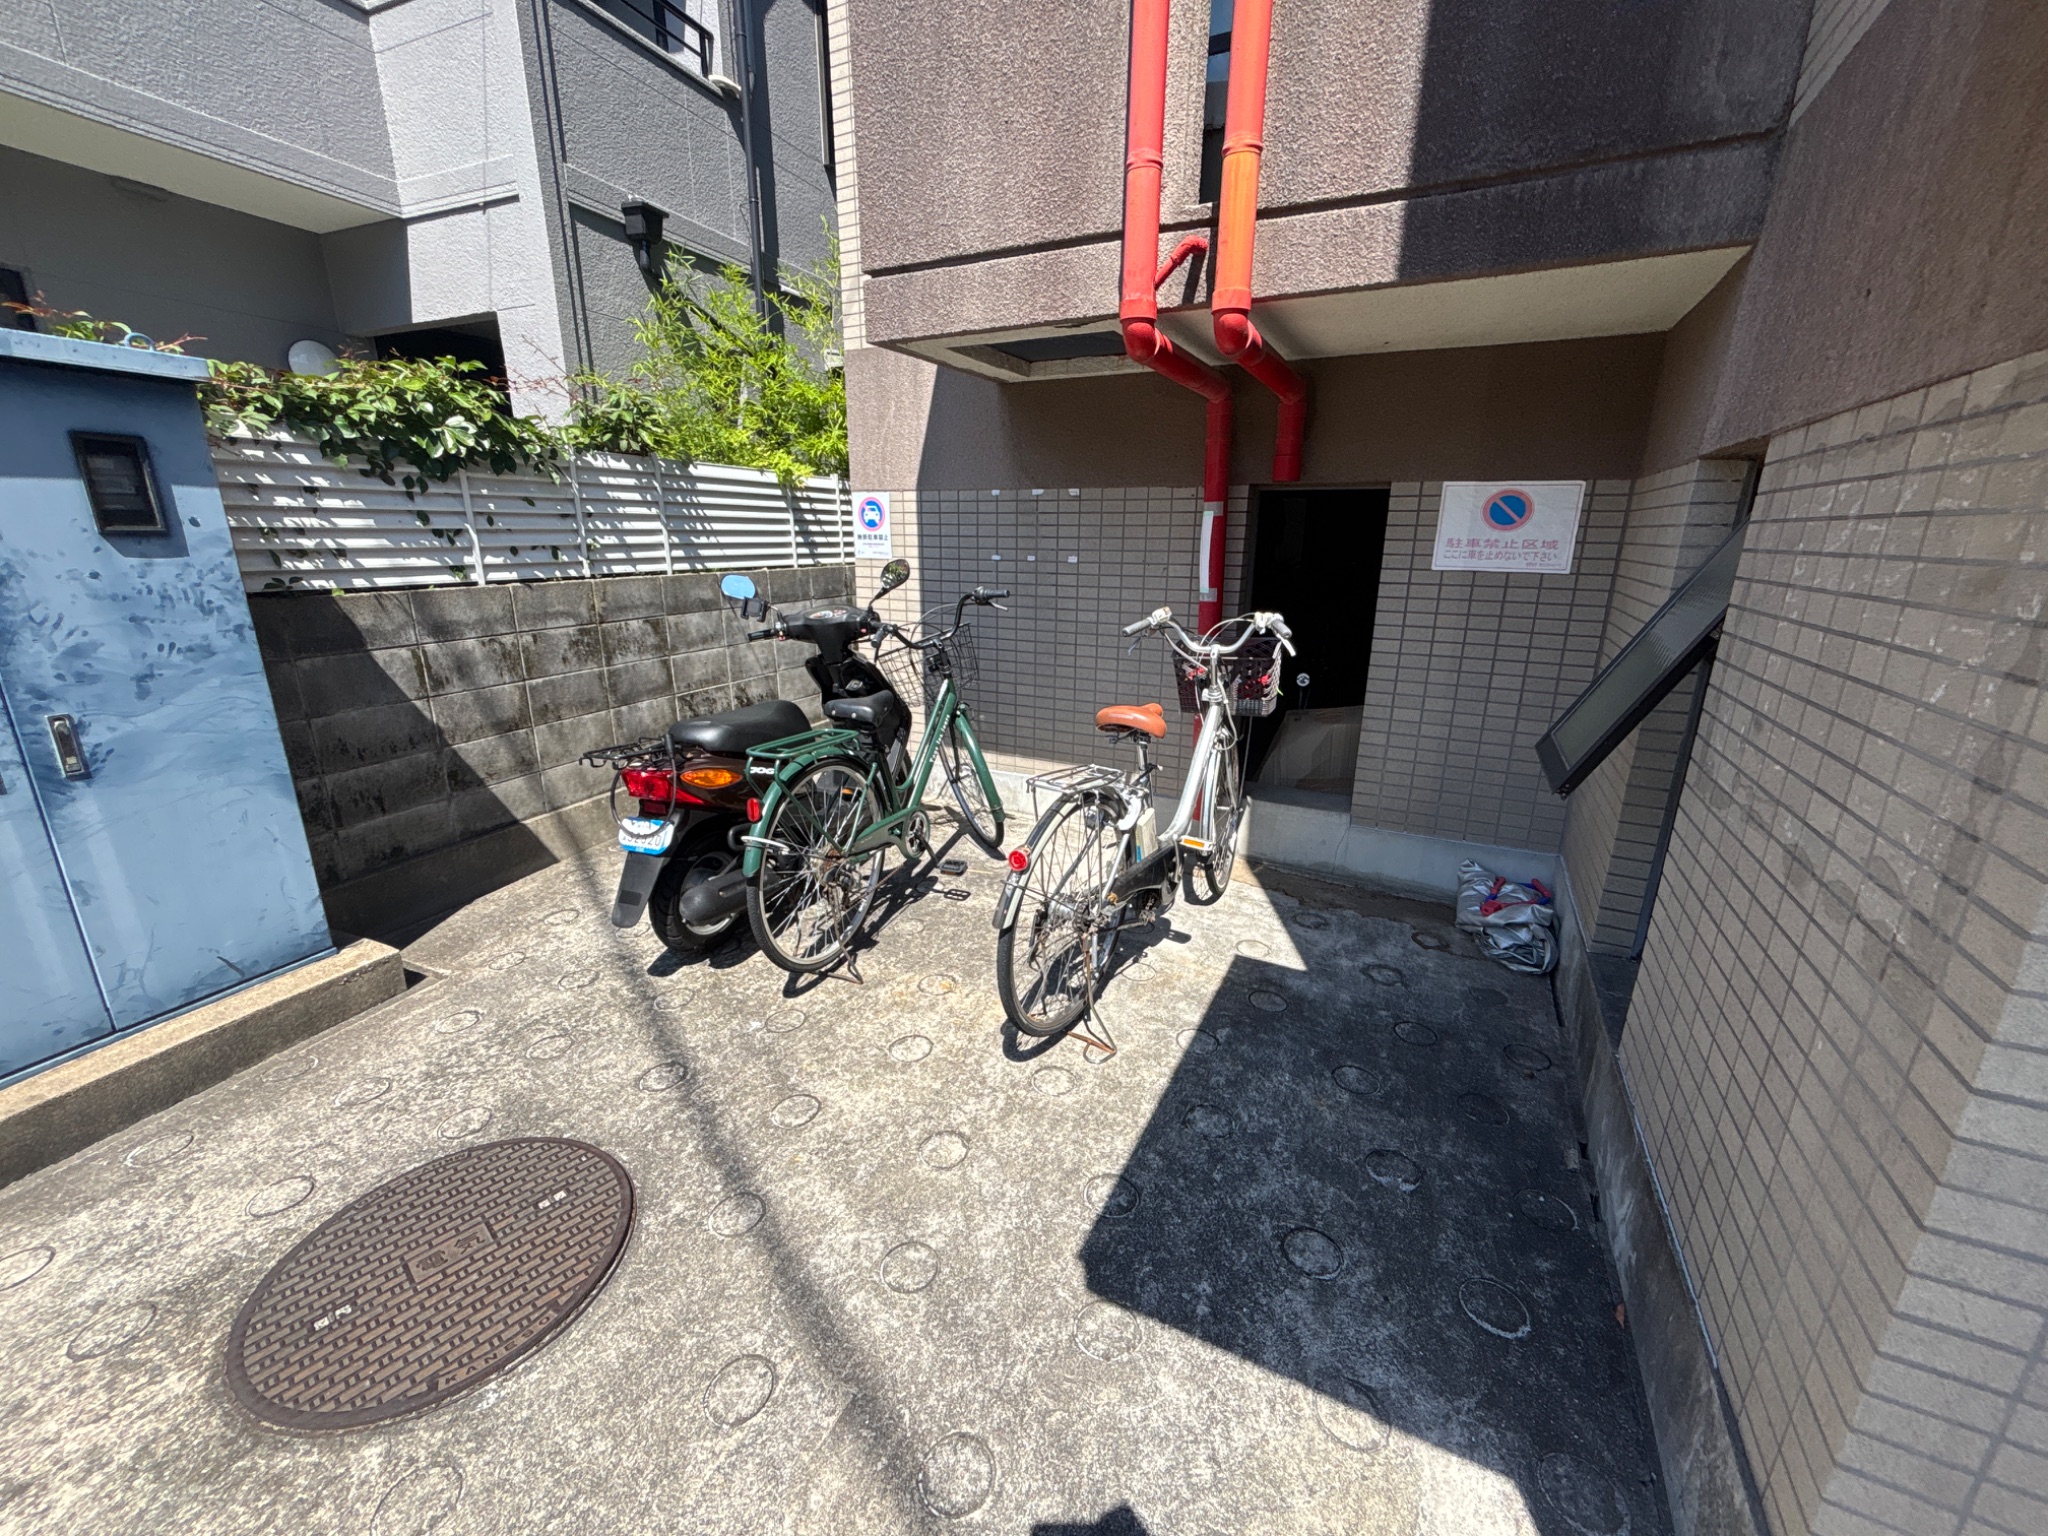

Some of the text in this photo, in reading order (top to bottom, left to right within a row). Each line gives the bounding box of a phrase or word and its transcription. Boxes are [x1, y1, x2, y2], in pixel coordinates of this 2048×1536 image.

[1445, 537, 1560, 550] 駐車禁止区域
[1443, 550, 1557, 561] ここに車を止めないで下さい
[750, 766, 775, 775] JOG
[415, 1231, 486, 1271] 電気
[444, 1315, 551, 1386] KANESO
